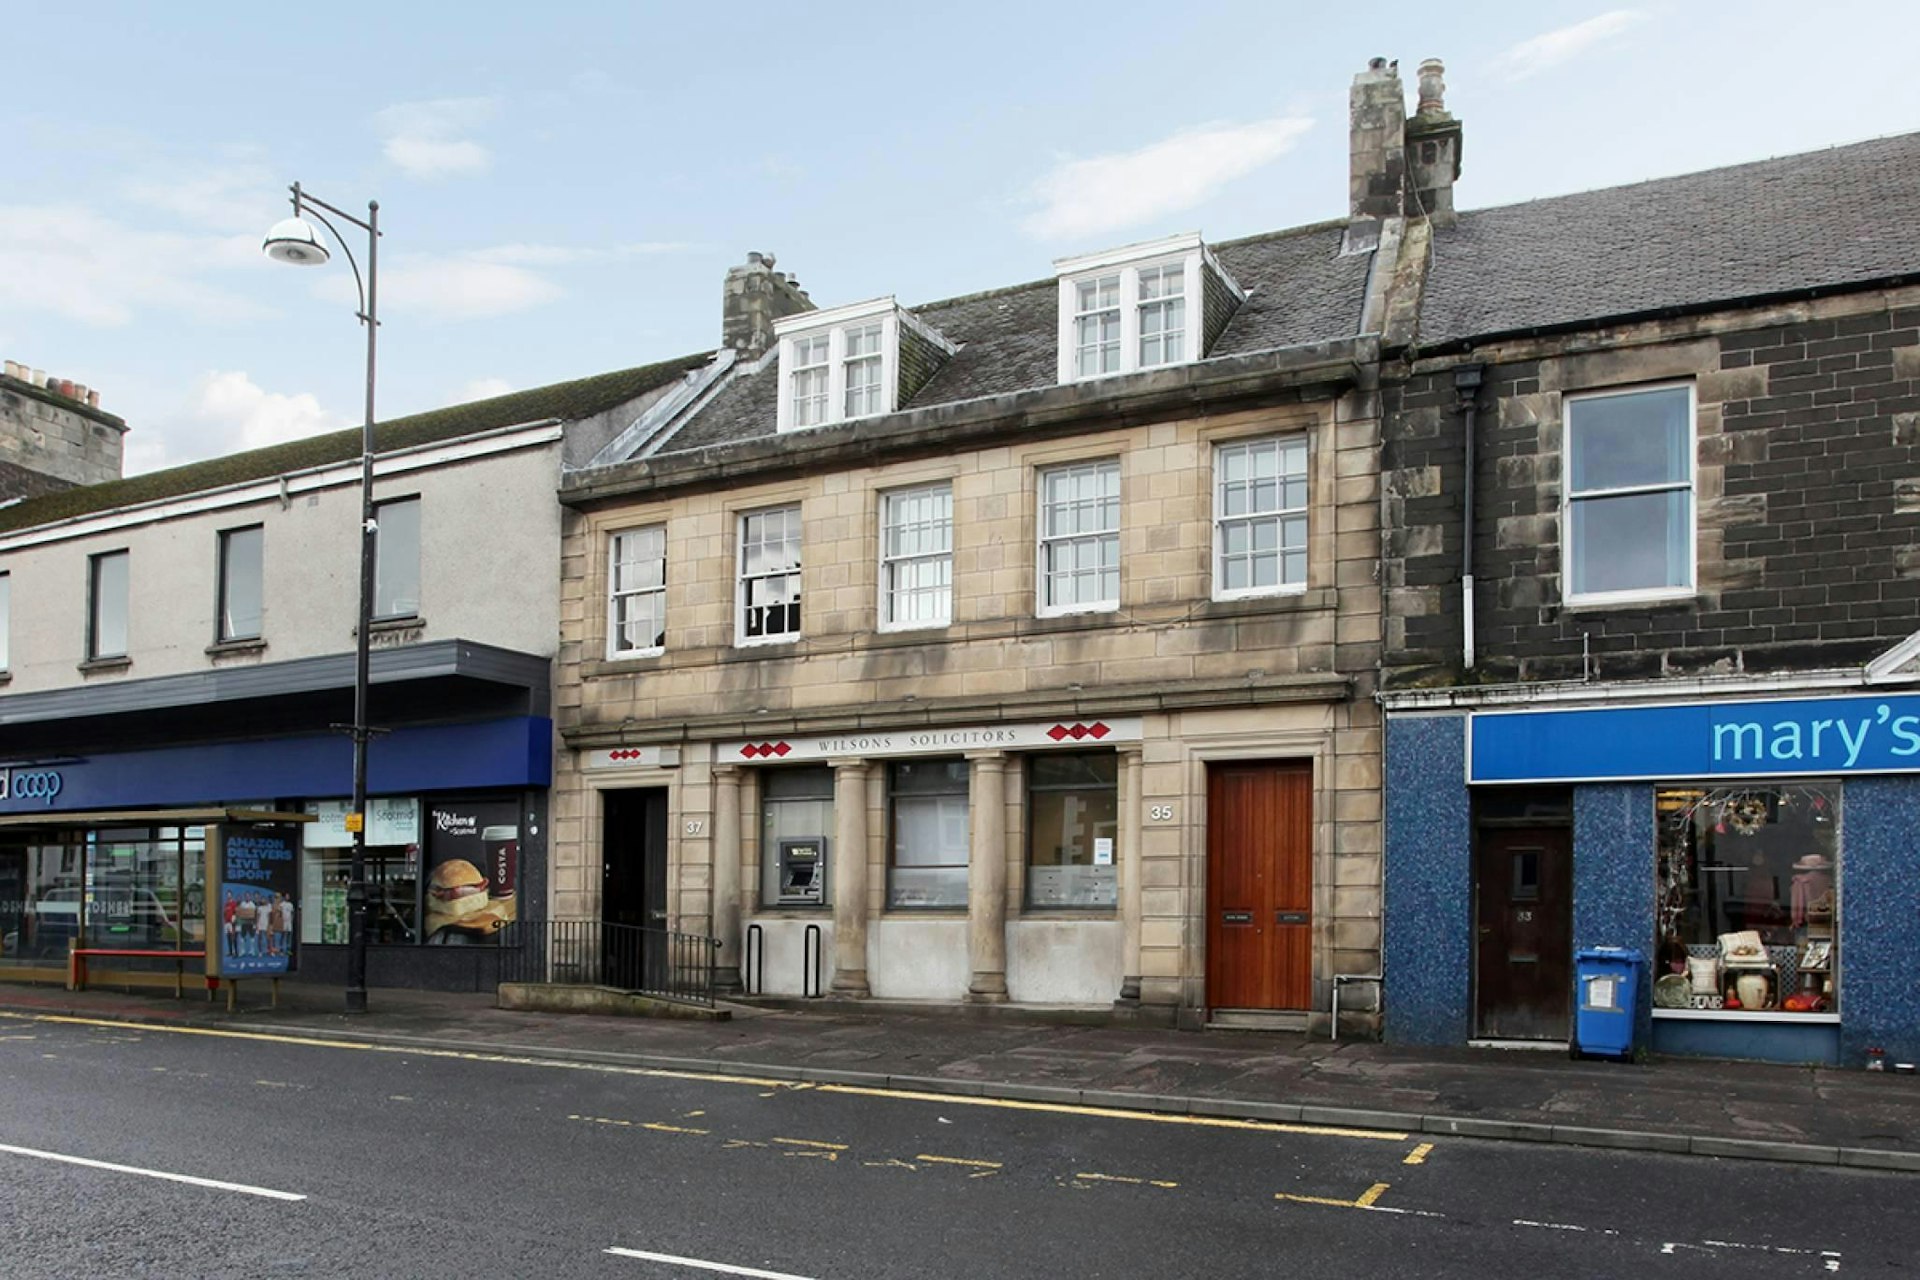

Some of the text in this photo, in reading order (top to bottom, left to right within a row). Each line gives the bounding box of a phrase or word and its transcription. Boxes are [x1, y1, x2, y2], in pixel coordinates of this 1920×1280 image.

[818, 729, 1016, 751] WILSONS SOLICITORS
[1714, 704, 1920, 767] mary's
[14, 771, 61, 804] coop
[1151, 805, 1172, 820] 35
[687, 821, 702, 834] 37
[227, 837, 284, 848] AMAZON
[227, 848, 292, 860] DELIVERS
[227, 858, 260, 869] LIVE
[498, 847, 507, 884] COSTA
[227, 869, 272, 880] SPORT
